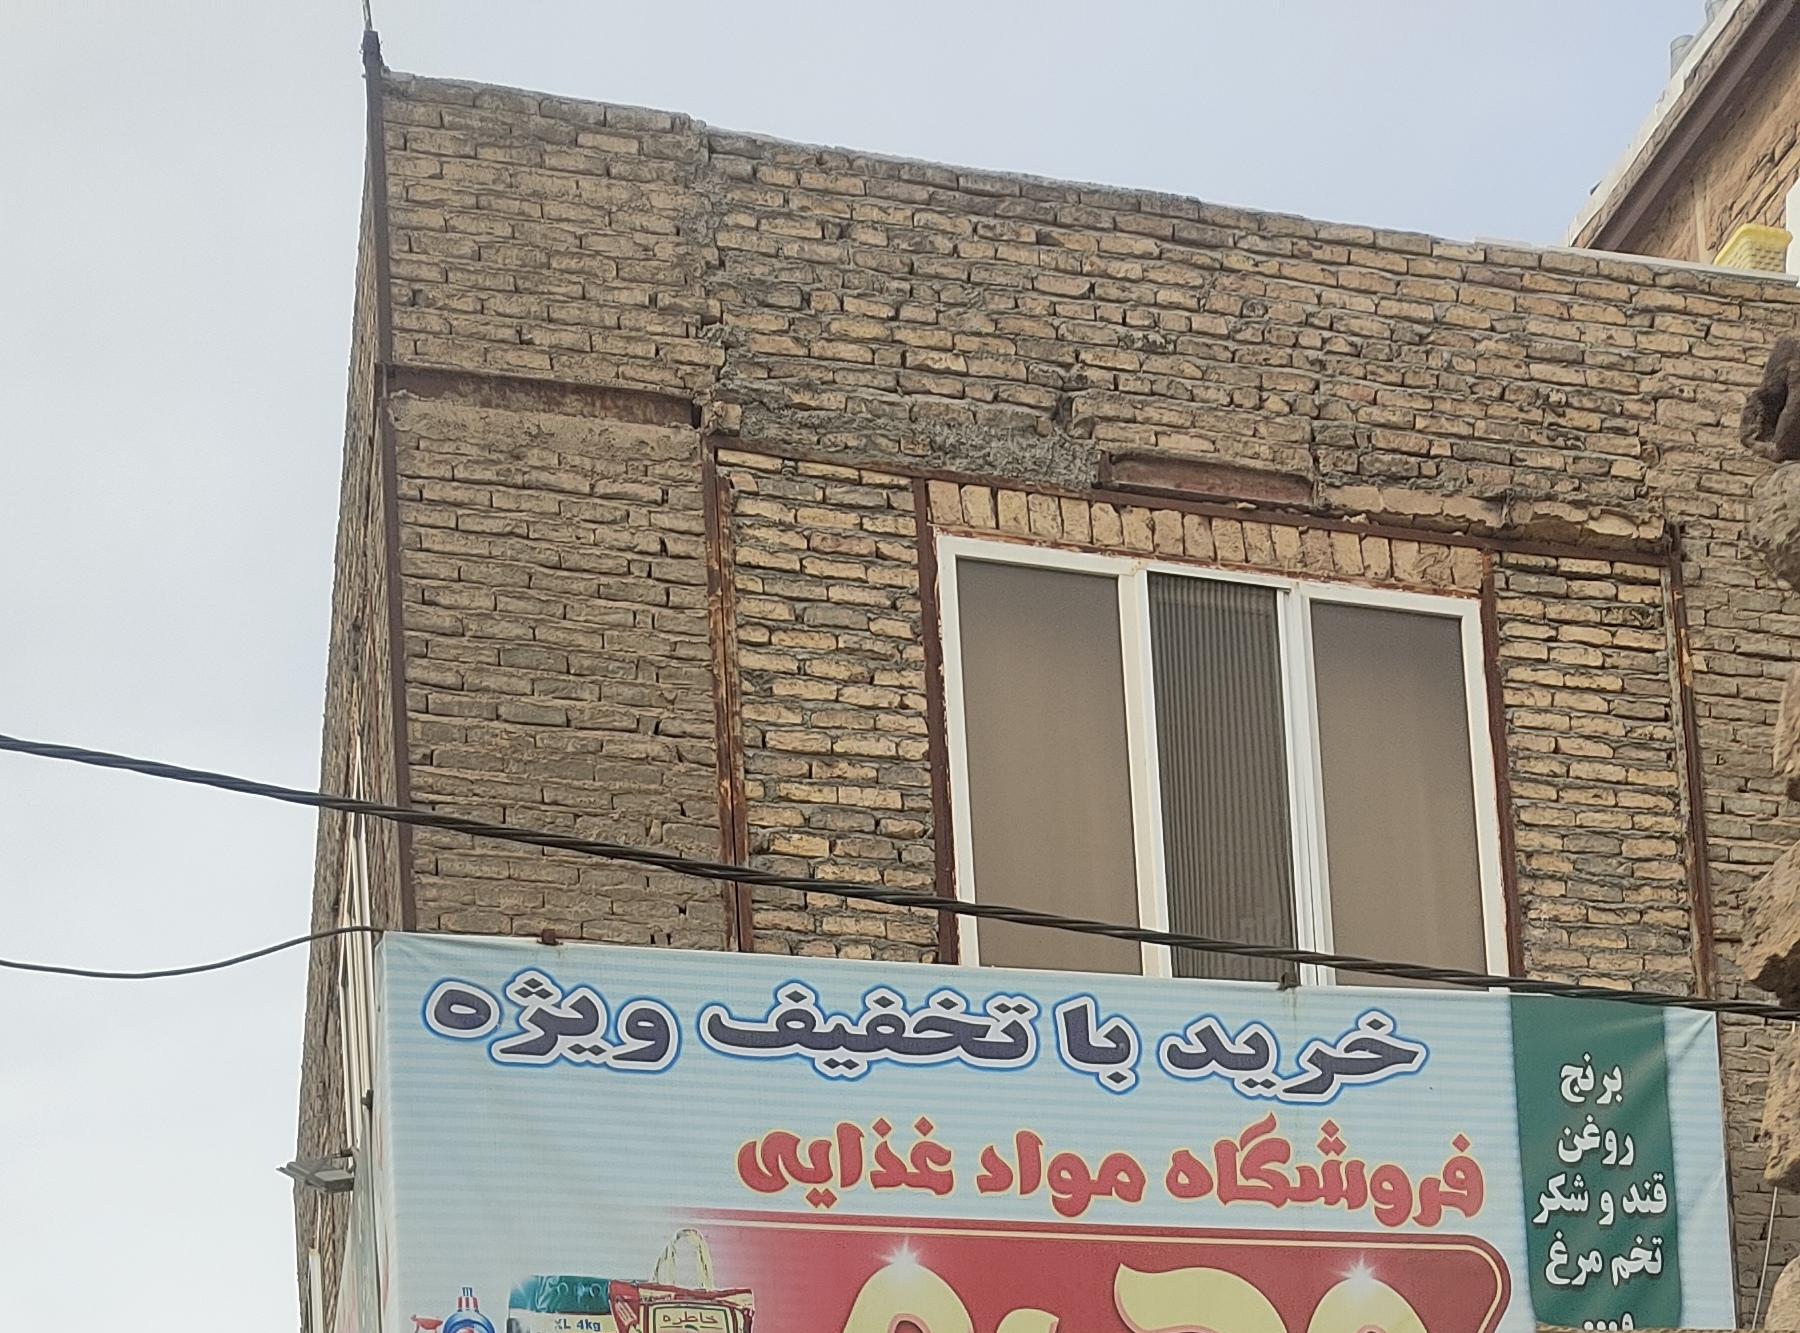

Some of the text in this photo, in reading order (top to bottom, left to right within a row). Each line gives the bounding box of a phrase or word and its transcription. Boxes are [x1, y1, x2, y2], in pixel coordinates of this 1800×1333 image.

[430, 973, 1423, 1097] خرید با تخفیف ویژه
[1560, 1053, 1623, 1104] برنج
[1559, 1114, 1634, 1165] روغن
[737, 1112, 1484, 1227] فروشگاه مواد غذایی
[1533, 1173, 1667, 1225] قند و شکر
[1545, 1231, 1663, 1287] تخم مرغ
[662, 1311, 719, 1325] خاطره
